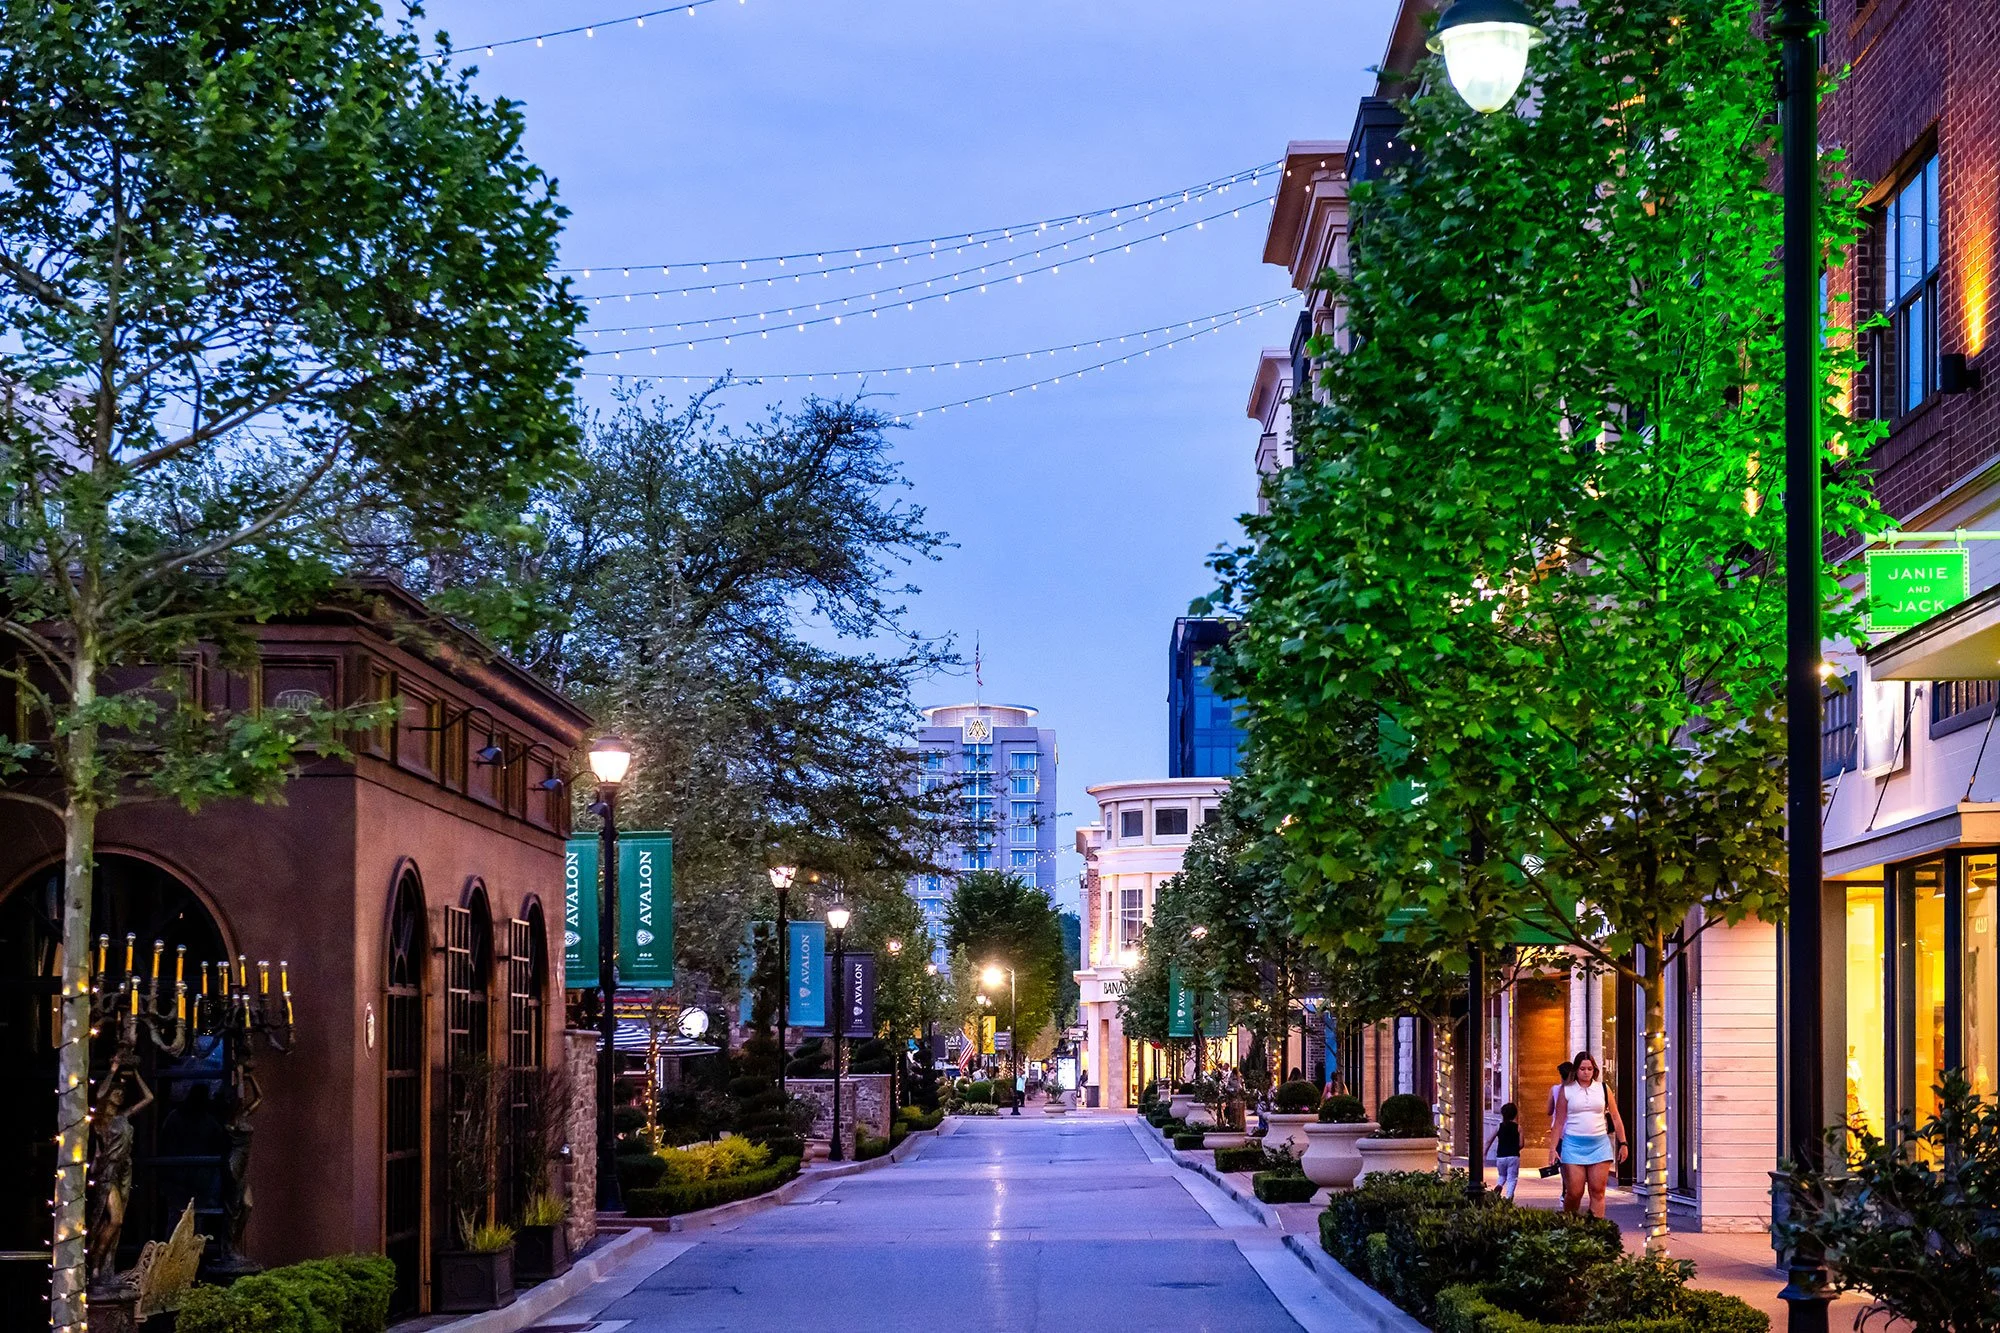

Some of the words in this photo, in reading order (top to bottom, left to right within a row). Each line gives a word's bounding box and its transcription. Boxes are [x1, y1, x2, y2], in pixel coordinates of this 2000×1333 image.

[1887, 567, 1949, 581] JANIE
[1893, 600, 1946, 613] JACK
[566, 852, 579, 927] AVALON
[639, 850, 652, 927] AVALON
[801, 934, 810, 985] AVALON
[854, 963, 862, 1005] AVALON
